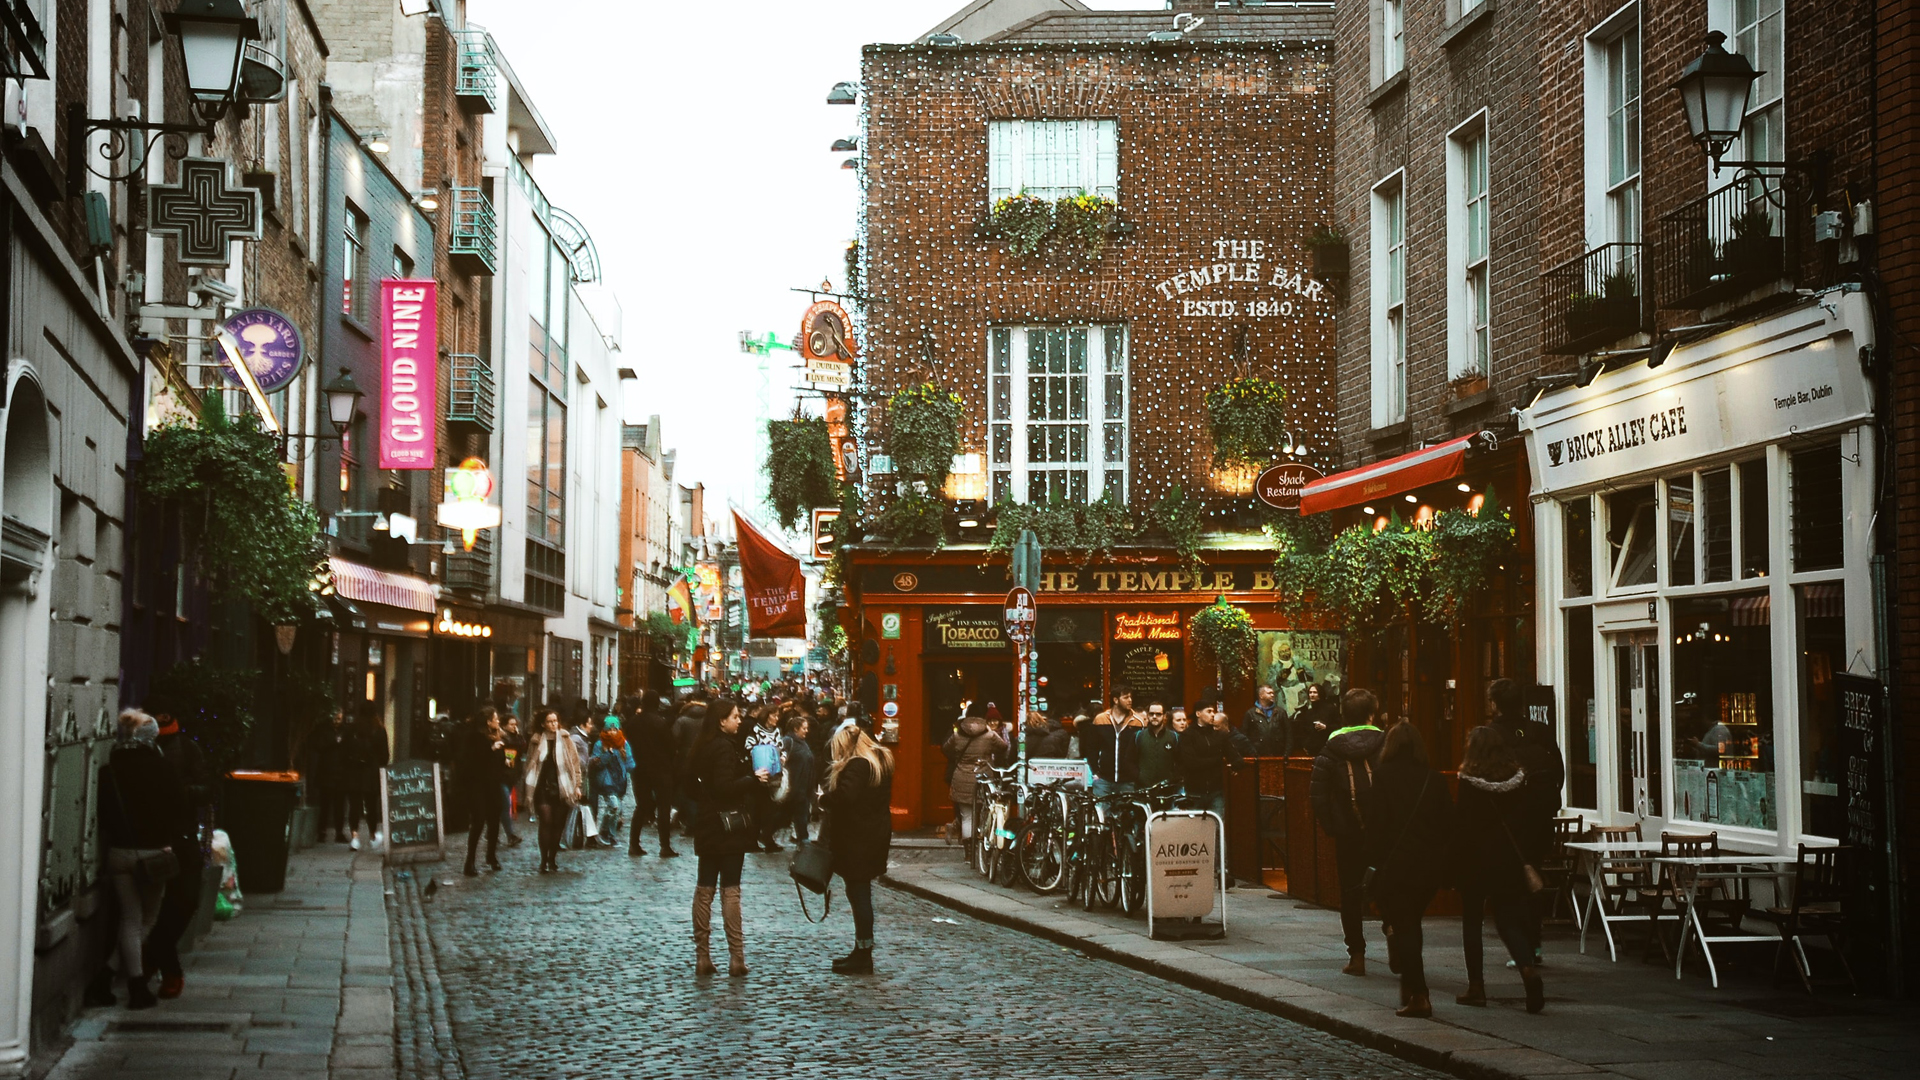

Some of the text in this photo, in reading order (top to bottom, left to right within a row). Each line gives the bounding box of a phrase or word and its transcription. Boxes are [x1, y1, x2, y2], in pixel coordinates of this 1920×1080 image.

[1213, 239, 1265, 259] THE
[1155, 262, 1323, 302] TEMPLE BAR
[1182, 300, 1293, 317] ESTD. 1840
[392, 287, 426, 349] NINE
[226, 313, 296, 348] EAL'S YARD
[815, 361, 842, 371] DUBLIN
[811, 374, 846, 385] LIVE MUSIC
[391, 358, 424, 442] CLOUD
[1773, 384, 1833, 410] Temple Bar, Dublin
[1566, 396, 1688, 464] BRICK ALLEY CAFÉ
[897, 575, 913, 587] 48
[1093, 571, 1235, 591] TEMPLE
[750, 591, 799, 608] TEMPLE
[765, 587, 785, 596] THE
[766, 604, 788, 616] BAR
[1115, 613, 1178, 627] Traditional
[1114, 627, 1180, 640] Irish Music
[1309, 650, 1339, 662] BAR
[1155, 842, 1209, 858] ARIOSA
